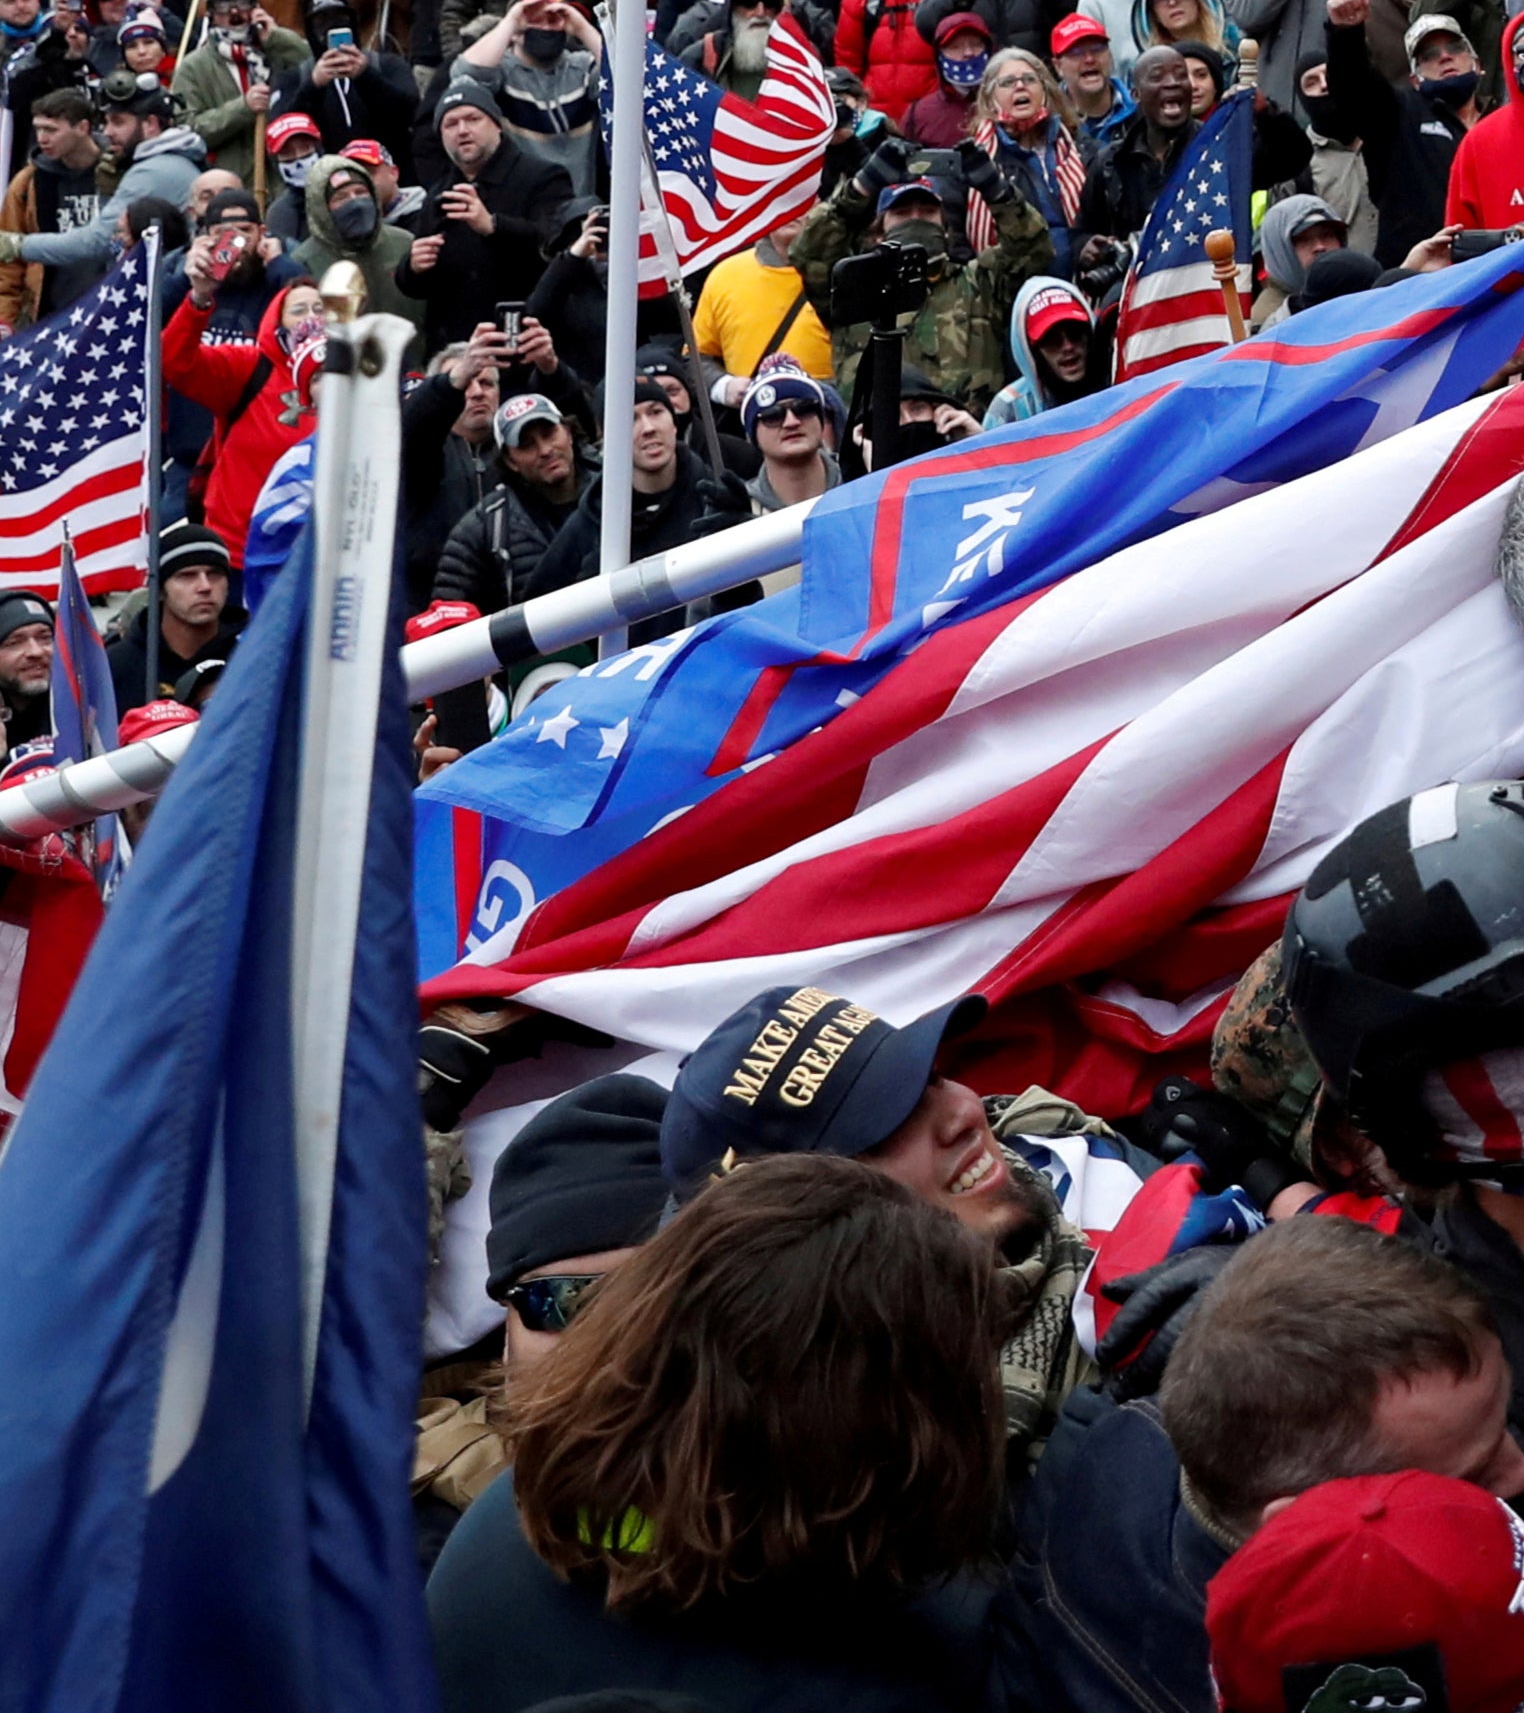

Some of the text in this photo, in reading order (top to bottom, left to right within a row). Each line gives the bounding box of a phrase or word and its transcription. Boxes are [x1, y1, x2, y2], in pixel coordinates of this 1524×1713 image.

[329, 576, 355, 662] Annin
[723, 1019, 799, 1107] MAKE
[779, 1023, 854, 1108] GREAT
